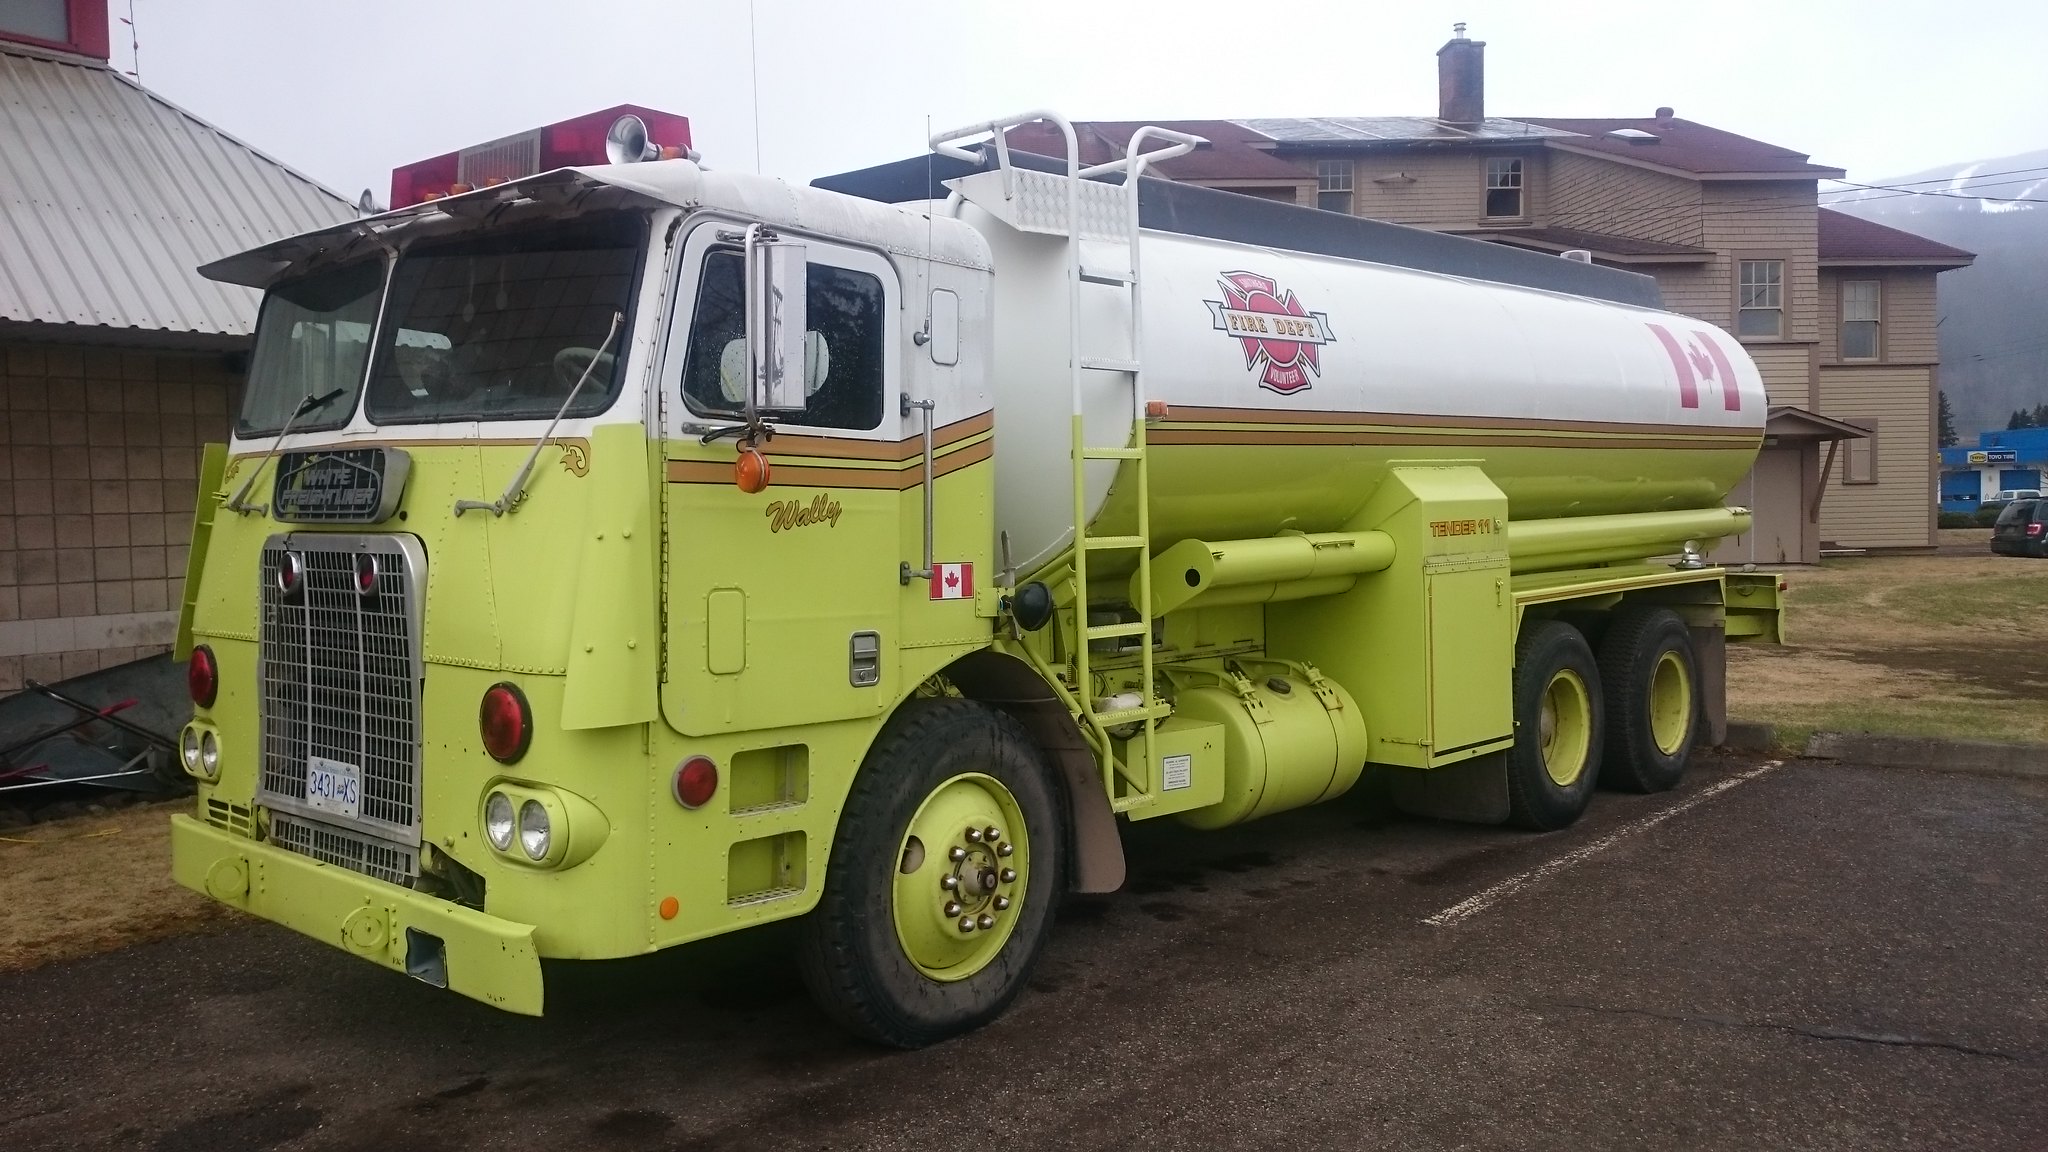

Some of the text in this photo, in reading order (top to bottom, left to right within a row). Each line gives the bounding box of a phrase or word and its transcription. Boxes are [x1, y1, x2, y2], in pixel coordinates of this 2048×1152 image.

[1228, 313, 1268, 333] FIRE
[303, 468, 352, 486] WHITE
[280, 487, 376, 506] FREIGHTLINER
[766, 492, 842, 534] Wally
[1430, 520, 1476, 537] TENDER
